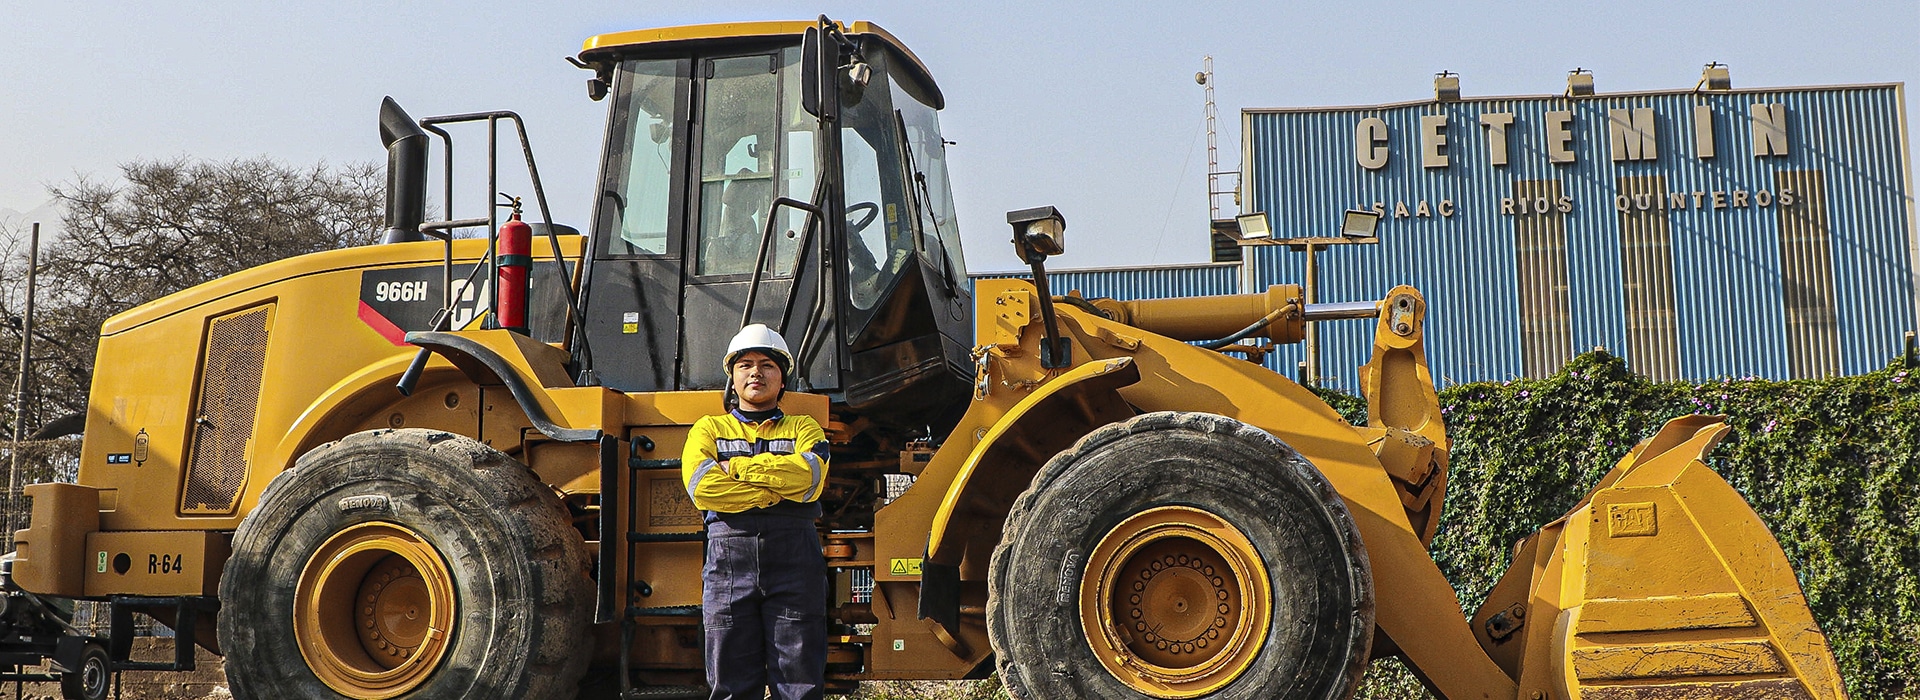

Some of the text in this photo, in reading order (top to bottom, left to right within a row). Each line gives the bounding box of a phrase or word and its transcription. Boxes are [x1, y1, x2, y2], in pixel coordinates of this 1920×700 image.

[1356, 103, 1788, 170] CETEMIN
[1500, 196, 1573, 216] RIOS
[1615, 189, 1794, 213] QUINTEROS
[376, 281, 428, 302] 966H
[148, 554, 182, 574] R-64
